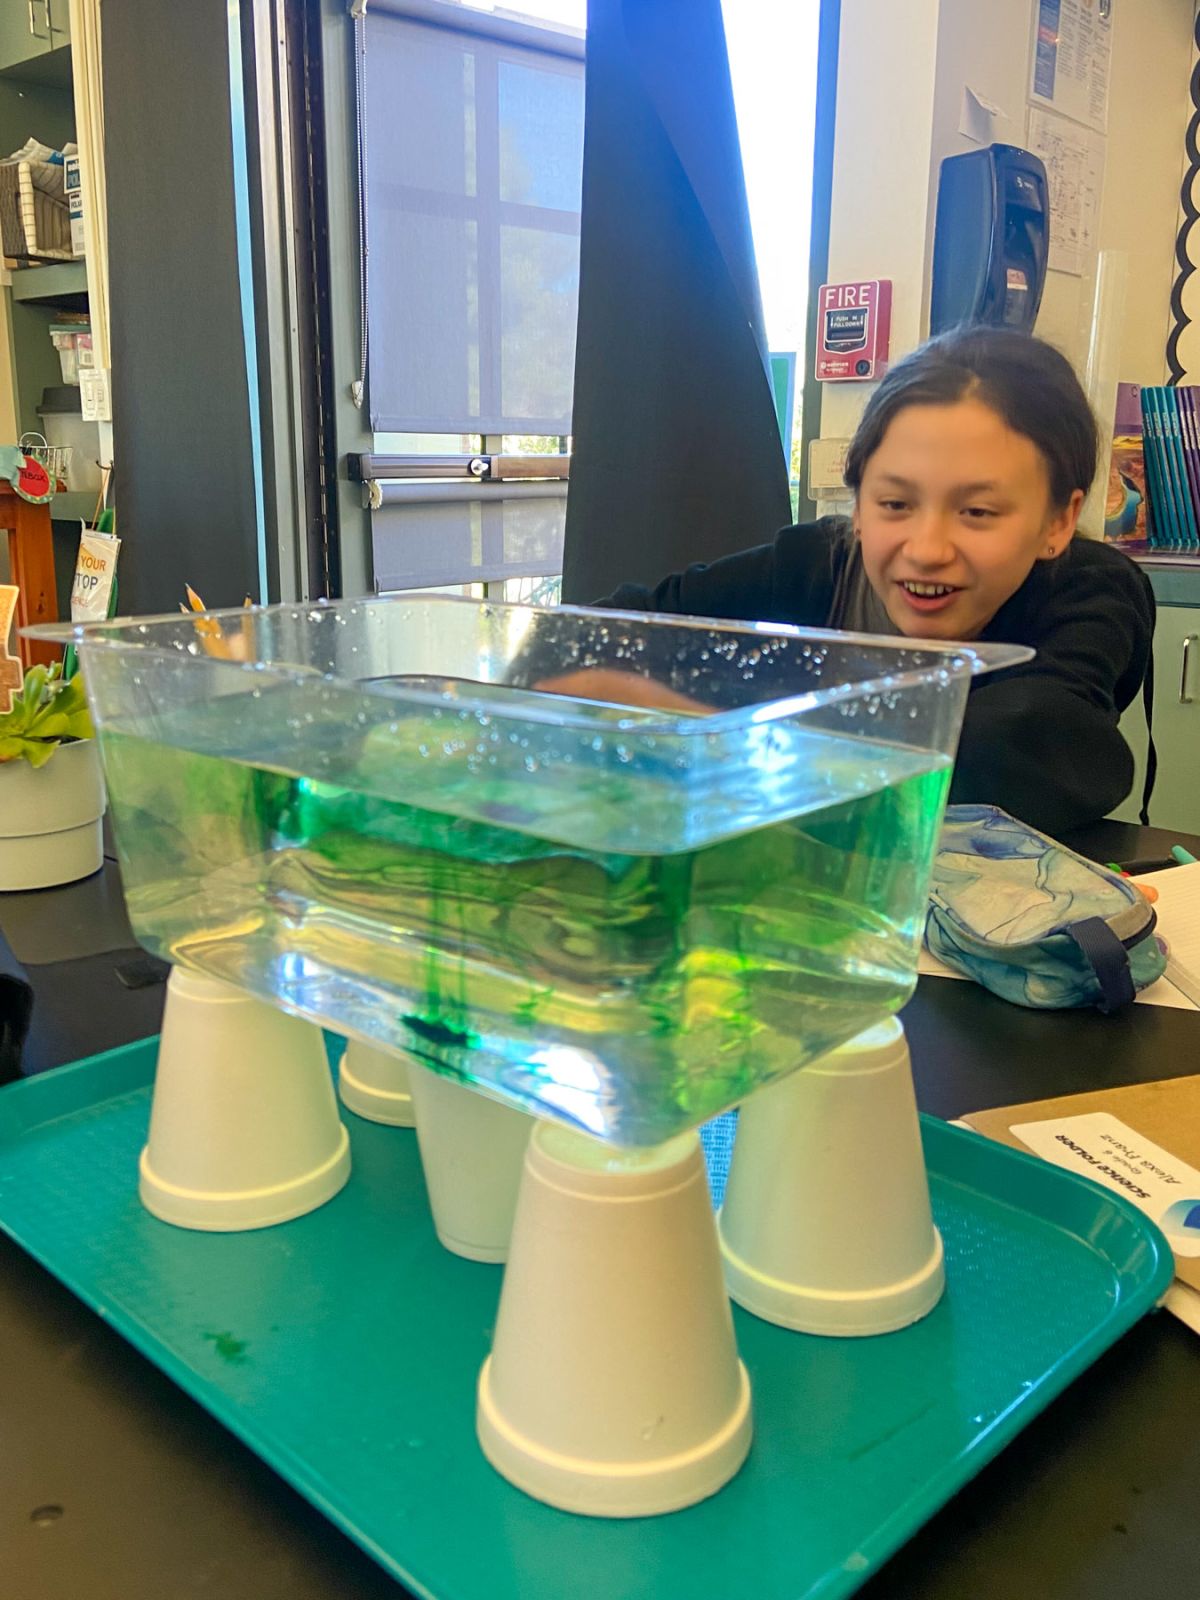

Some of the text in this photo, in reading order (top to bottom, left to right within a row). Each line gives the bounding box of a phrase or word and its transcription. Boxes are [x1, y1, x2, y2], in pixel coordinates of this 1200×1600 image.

[825, 285, 871, 308] FIRE
[80, 555, 106, 571] YOUR
[1140, 1160, 1182, 1185] Alexa
